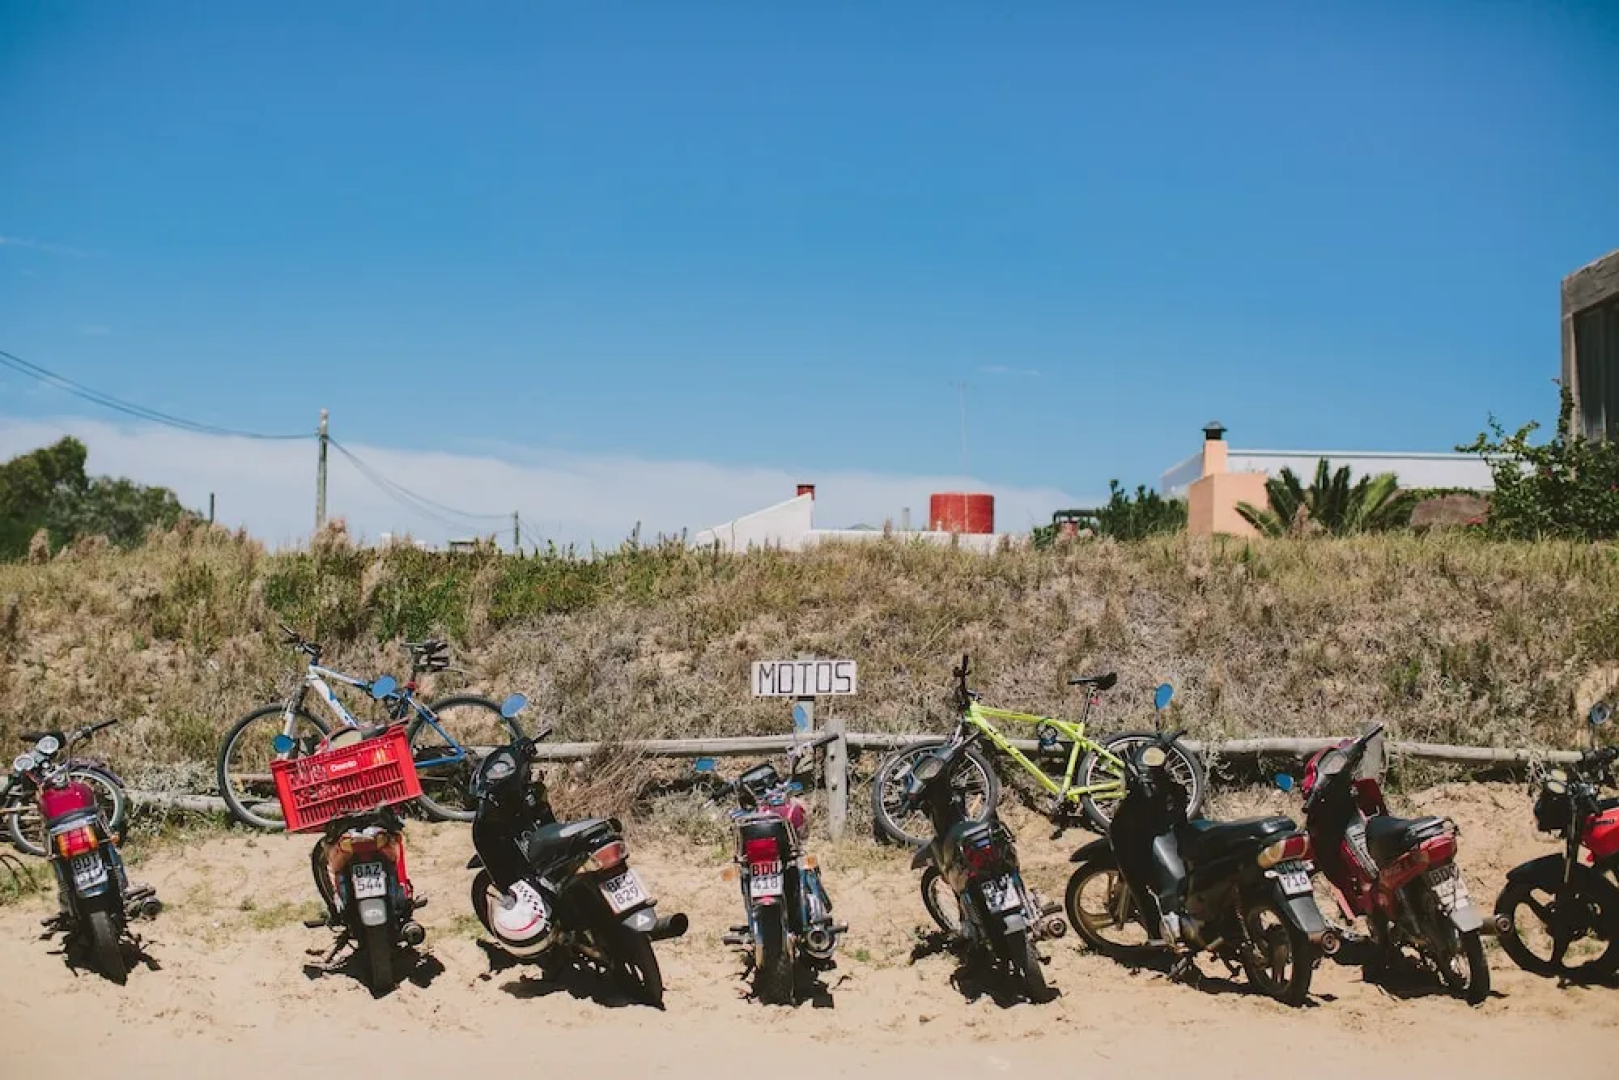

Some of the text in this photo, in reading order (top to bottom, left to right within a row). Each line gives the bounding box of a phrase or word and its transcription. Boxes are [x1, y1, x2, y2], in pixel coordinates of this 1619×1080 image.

[759, 662, 851, 694] MOTOS
[752, 862, 778, 877] BDU
[357, 876, 382, 891] 544
[1283, 874, 1308, 887] 716
[614, 886, 639, 904] 829
